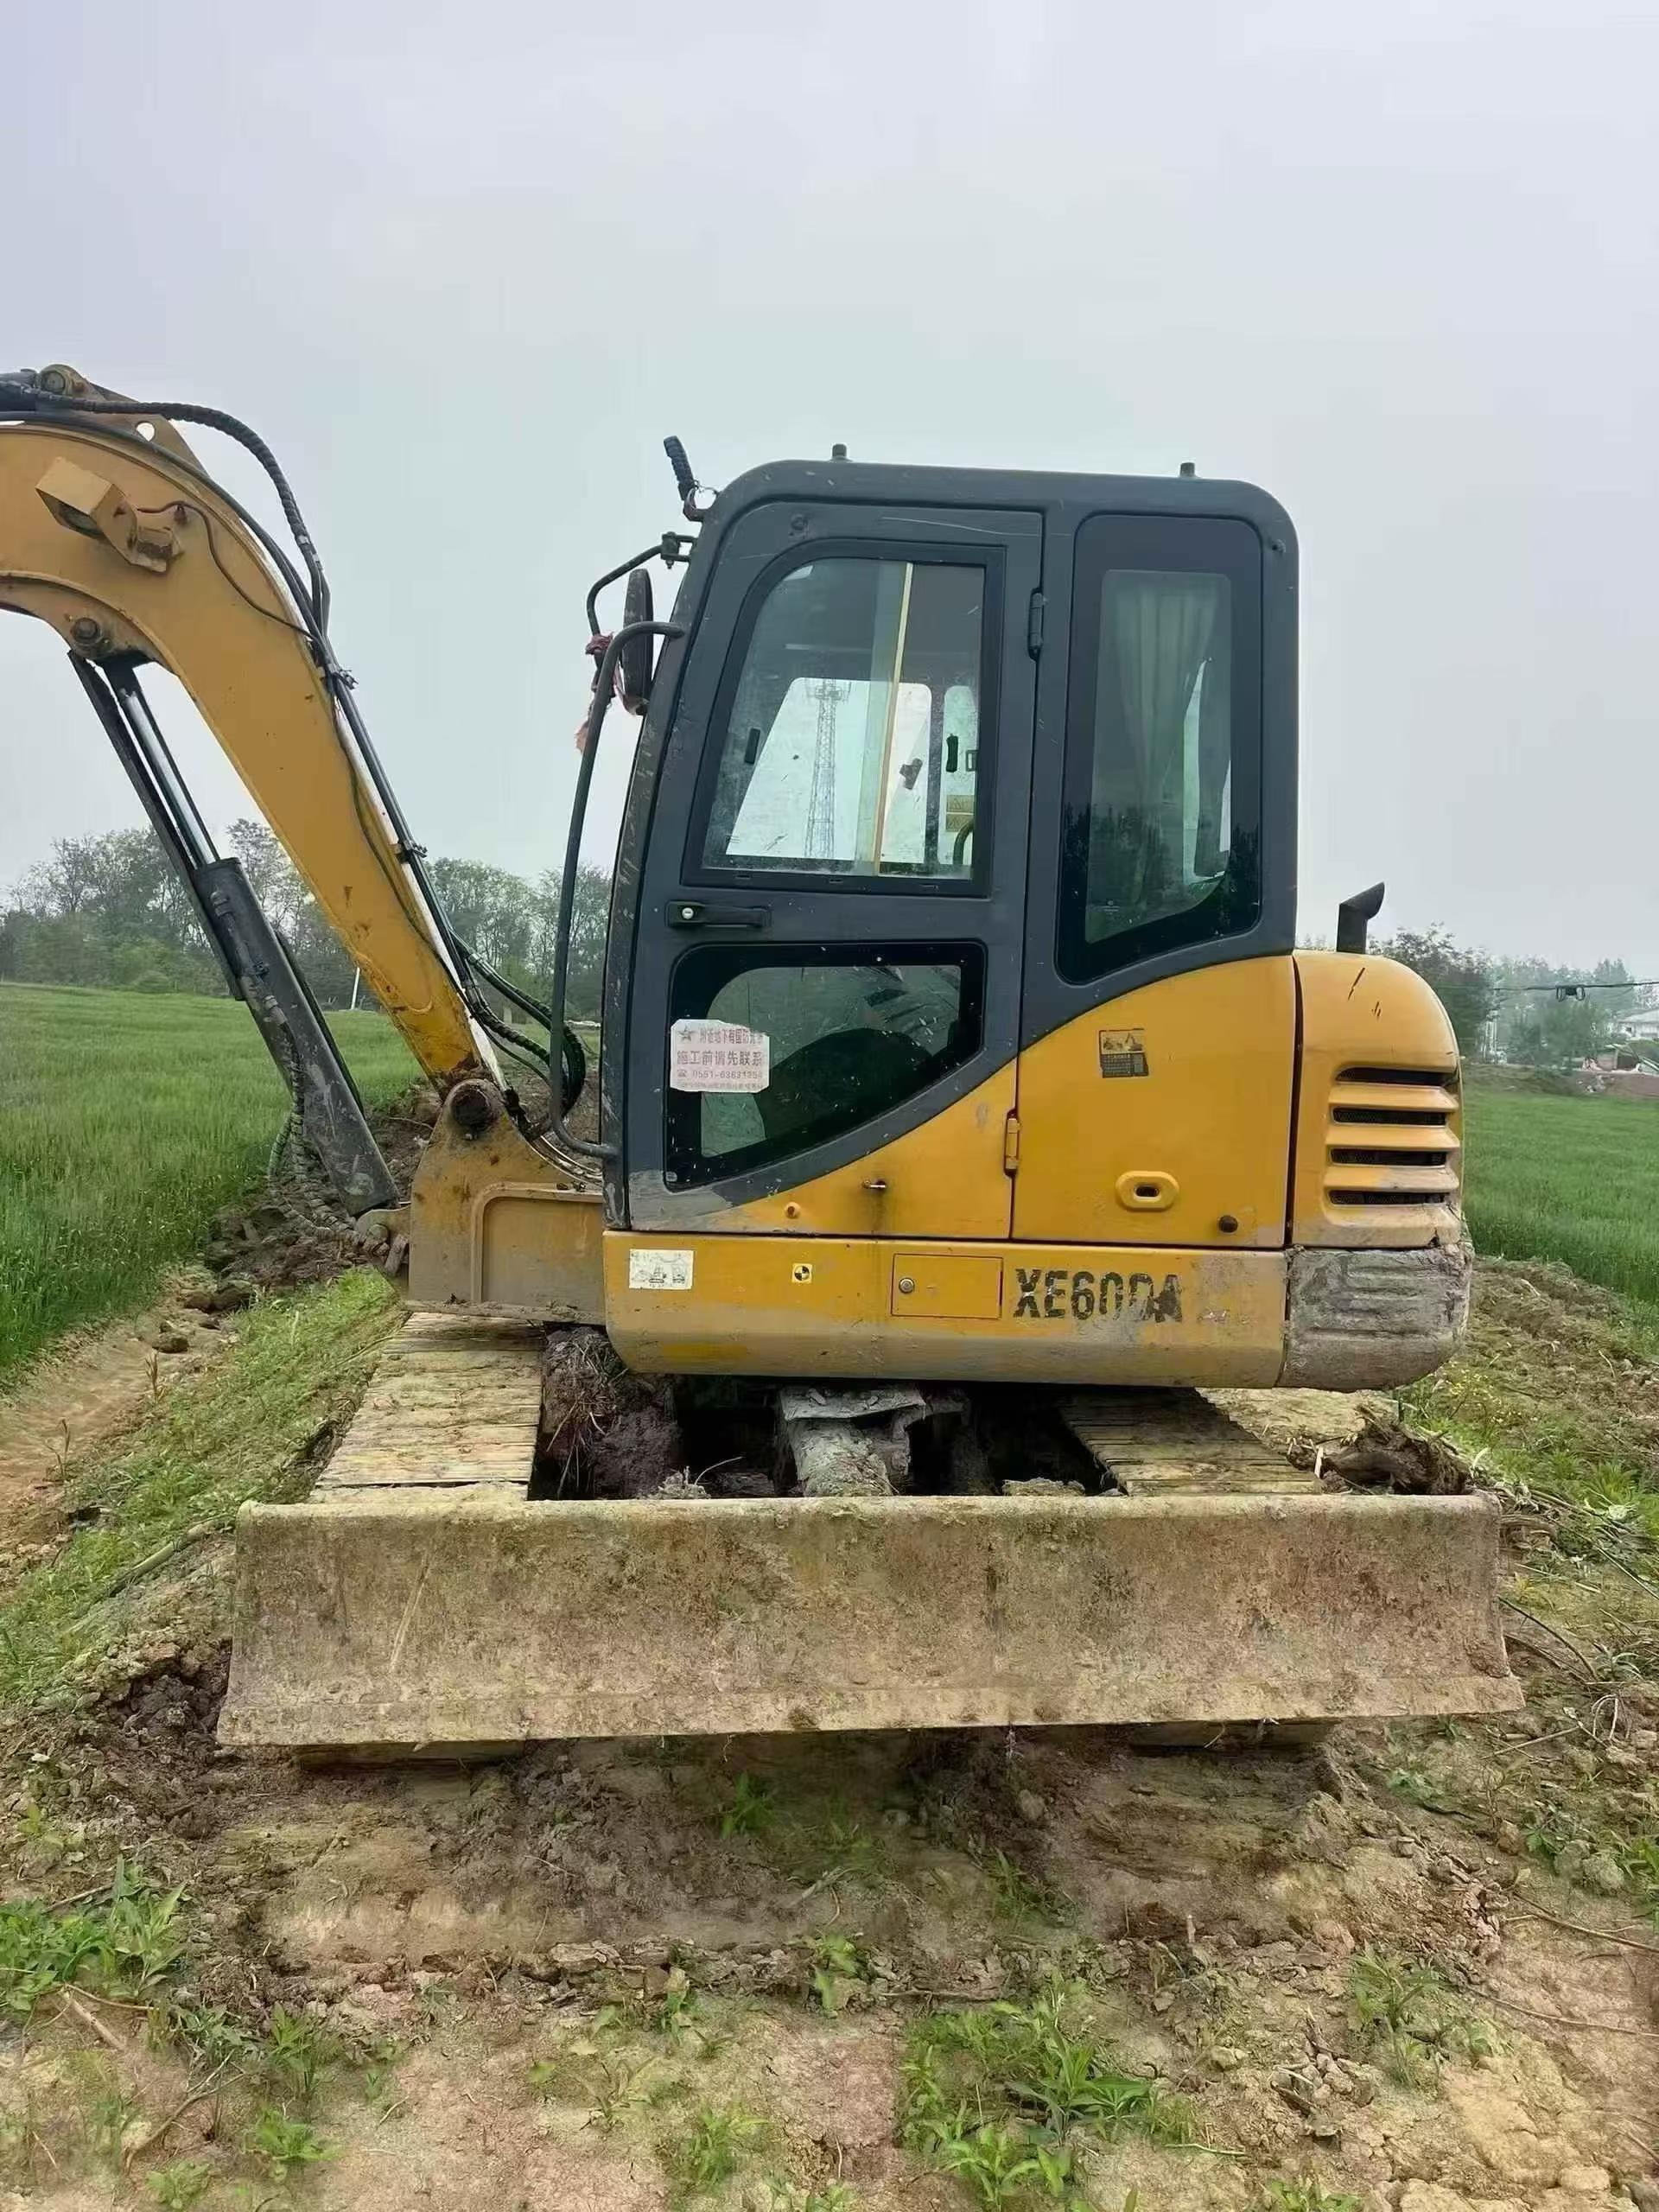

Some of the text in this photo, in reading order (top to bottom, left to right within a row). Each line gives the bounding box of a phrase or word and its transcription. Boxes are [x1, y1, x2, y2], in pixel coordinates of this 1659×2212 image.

[677, 1050, 762, 1065] 施工前请先联系
